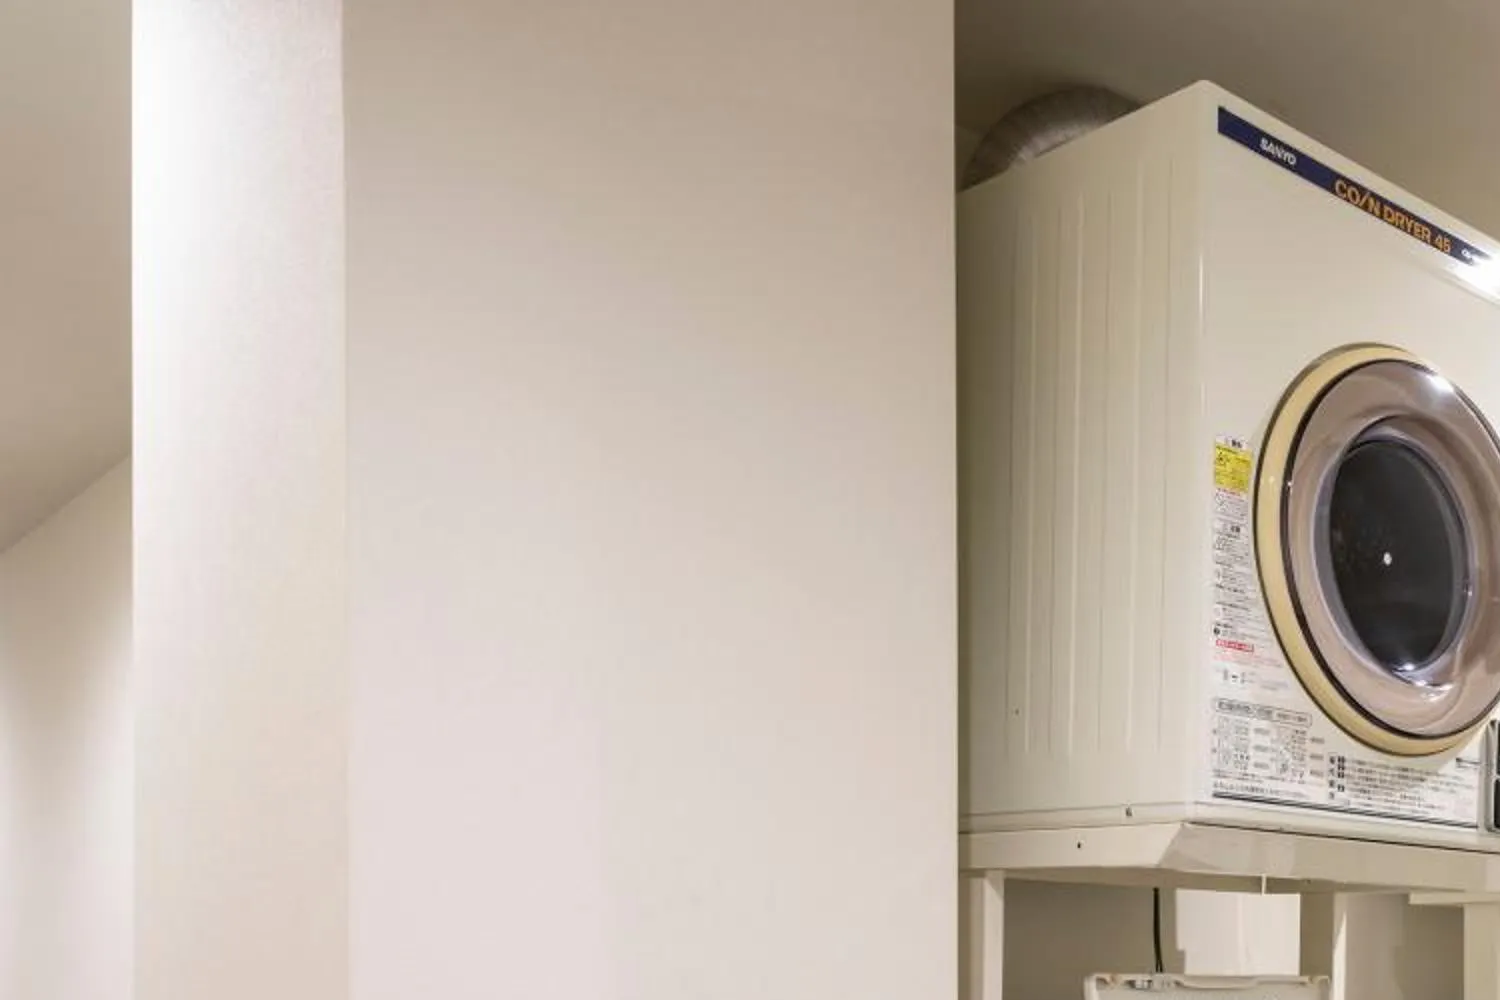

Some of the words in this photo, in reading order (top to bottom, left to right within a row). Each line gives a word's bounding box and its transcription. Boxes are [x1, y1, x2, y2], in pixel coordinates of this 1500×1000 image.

[1260, 136, 1297, 166] SANYO
[1383, 205, 1431, 245] DRYER
[1434, 234, 1452, 254] 45
